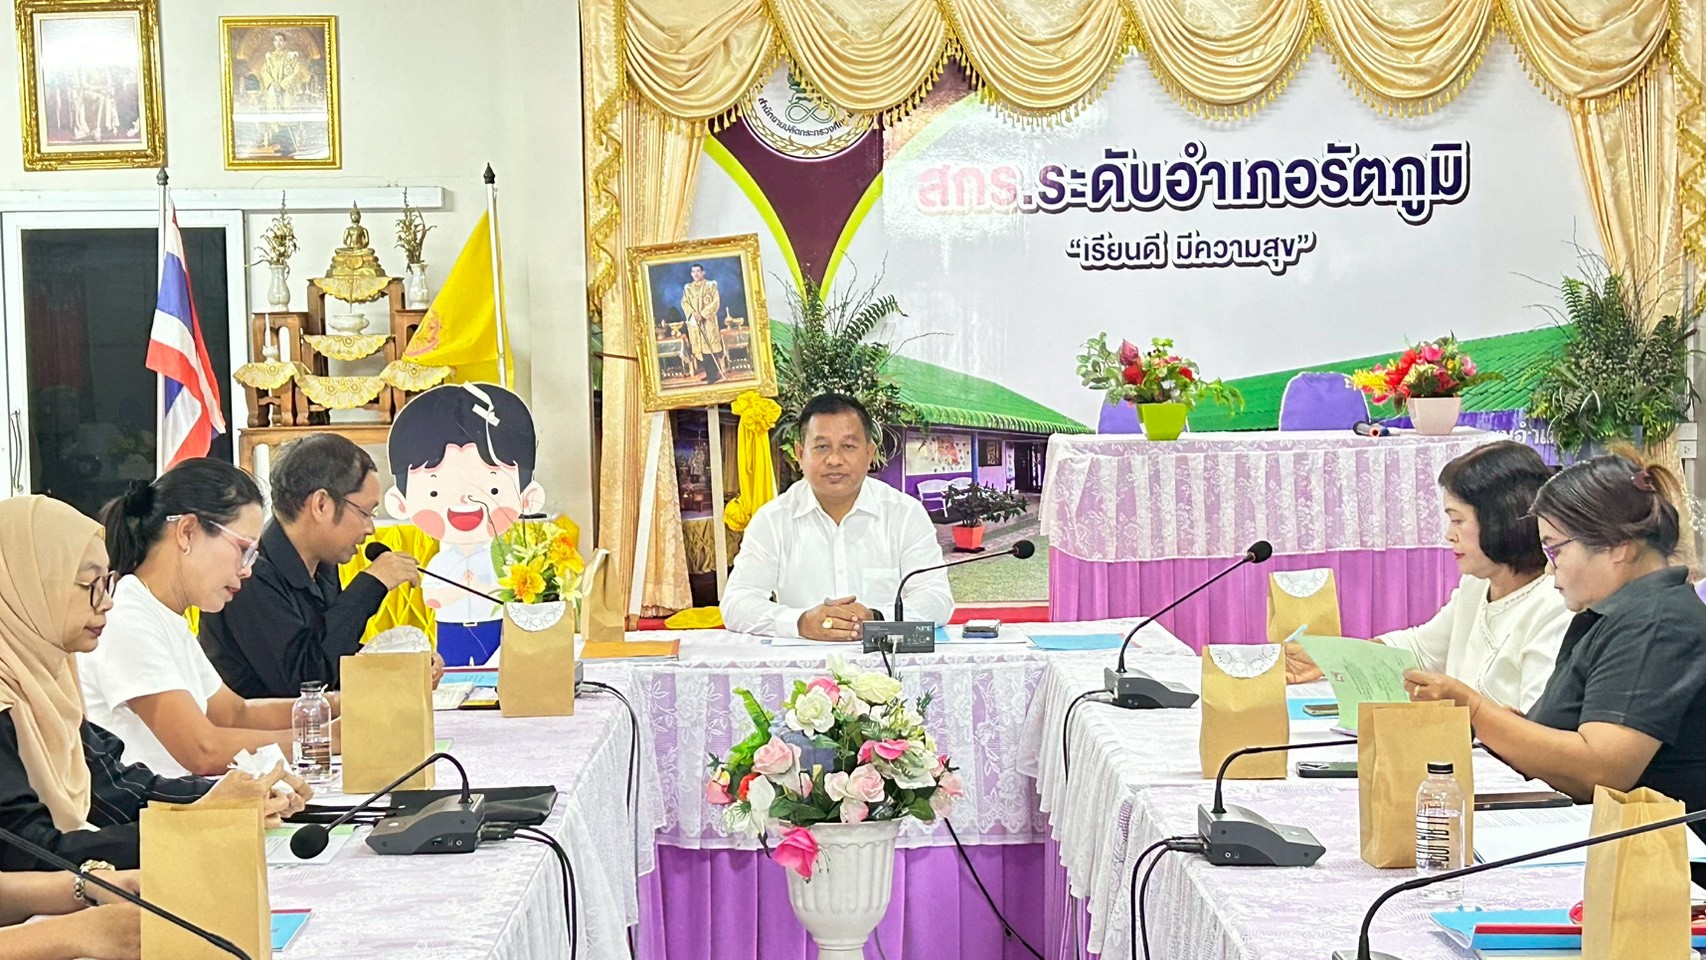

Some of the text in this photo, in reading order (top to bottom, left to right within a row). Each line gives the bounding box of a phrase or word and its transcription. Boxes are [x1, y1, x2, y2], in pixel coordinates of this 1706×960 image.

[918, 141, 1463, 217] สกร.ระดับอำเภอรัตภูมิ
[1070, 231, 1310, 267] “เรียนดี มีความสุข”
